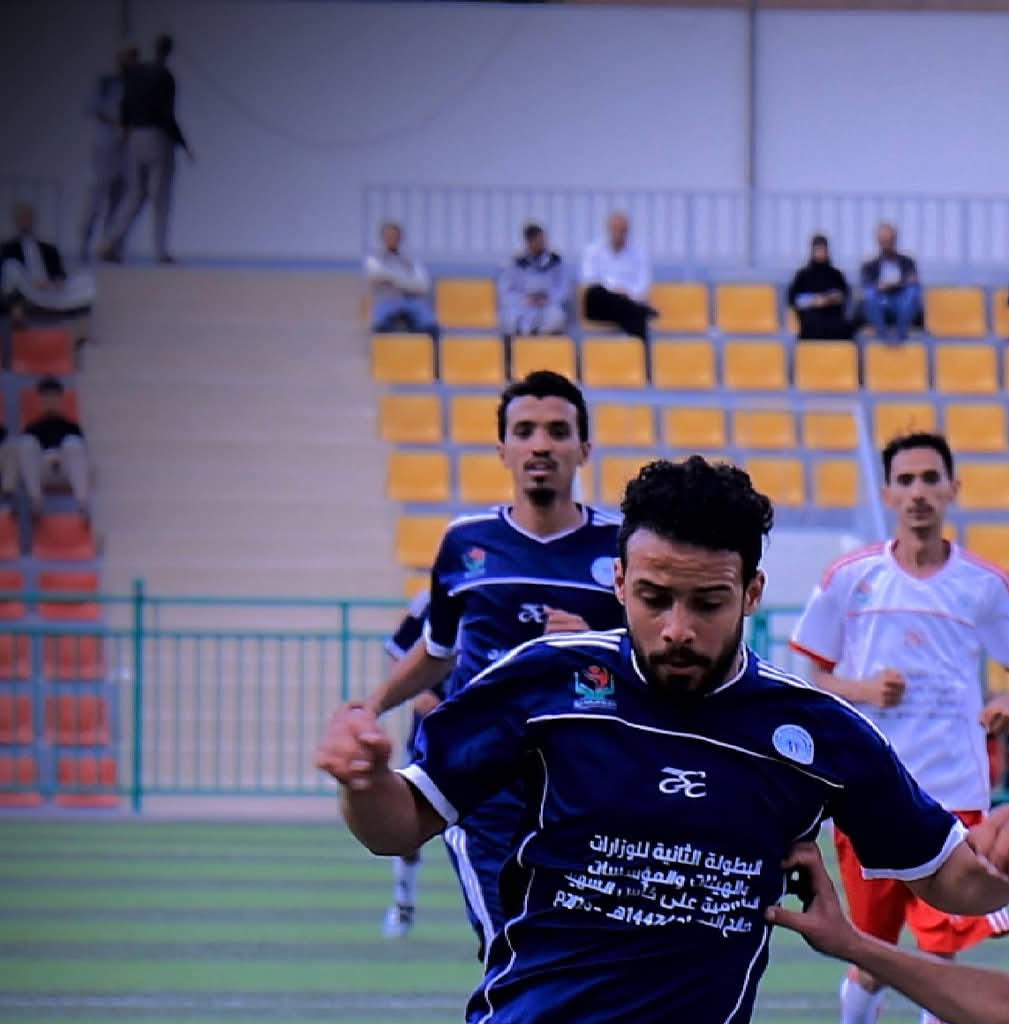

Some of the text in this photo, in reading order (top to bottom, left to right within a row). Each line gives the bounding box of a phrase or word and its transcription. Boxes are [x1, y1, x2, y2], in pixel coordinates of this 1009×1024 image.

[589, 834, 651, 861] للوزارات
[652, 842, 702, 867] الثانية
[660, 892, 698, 910] على
